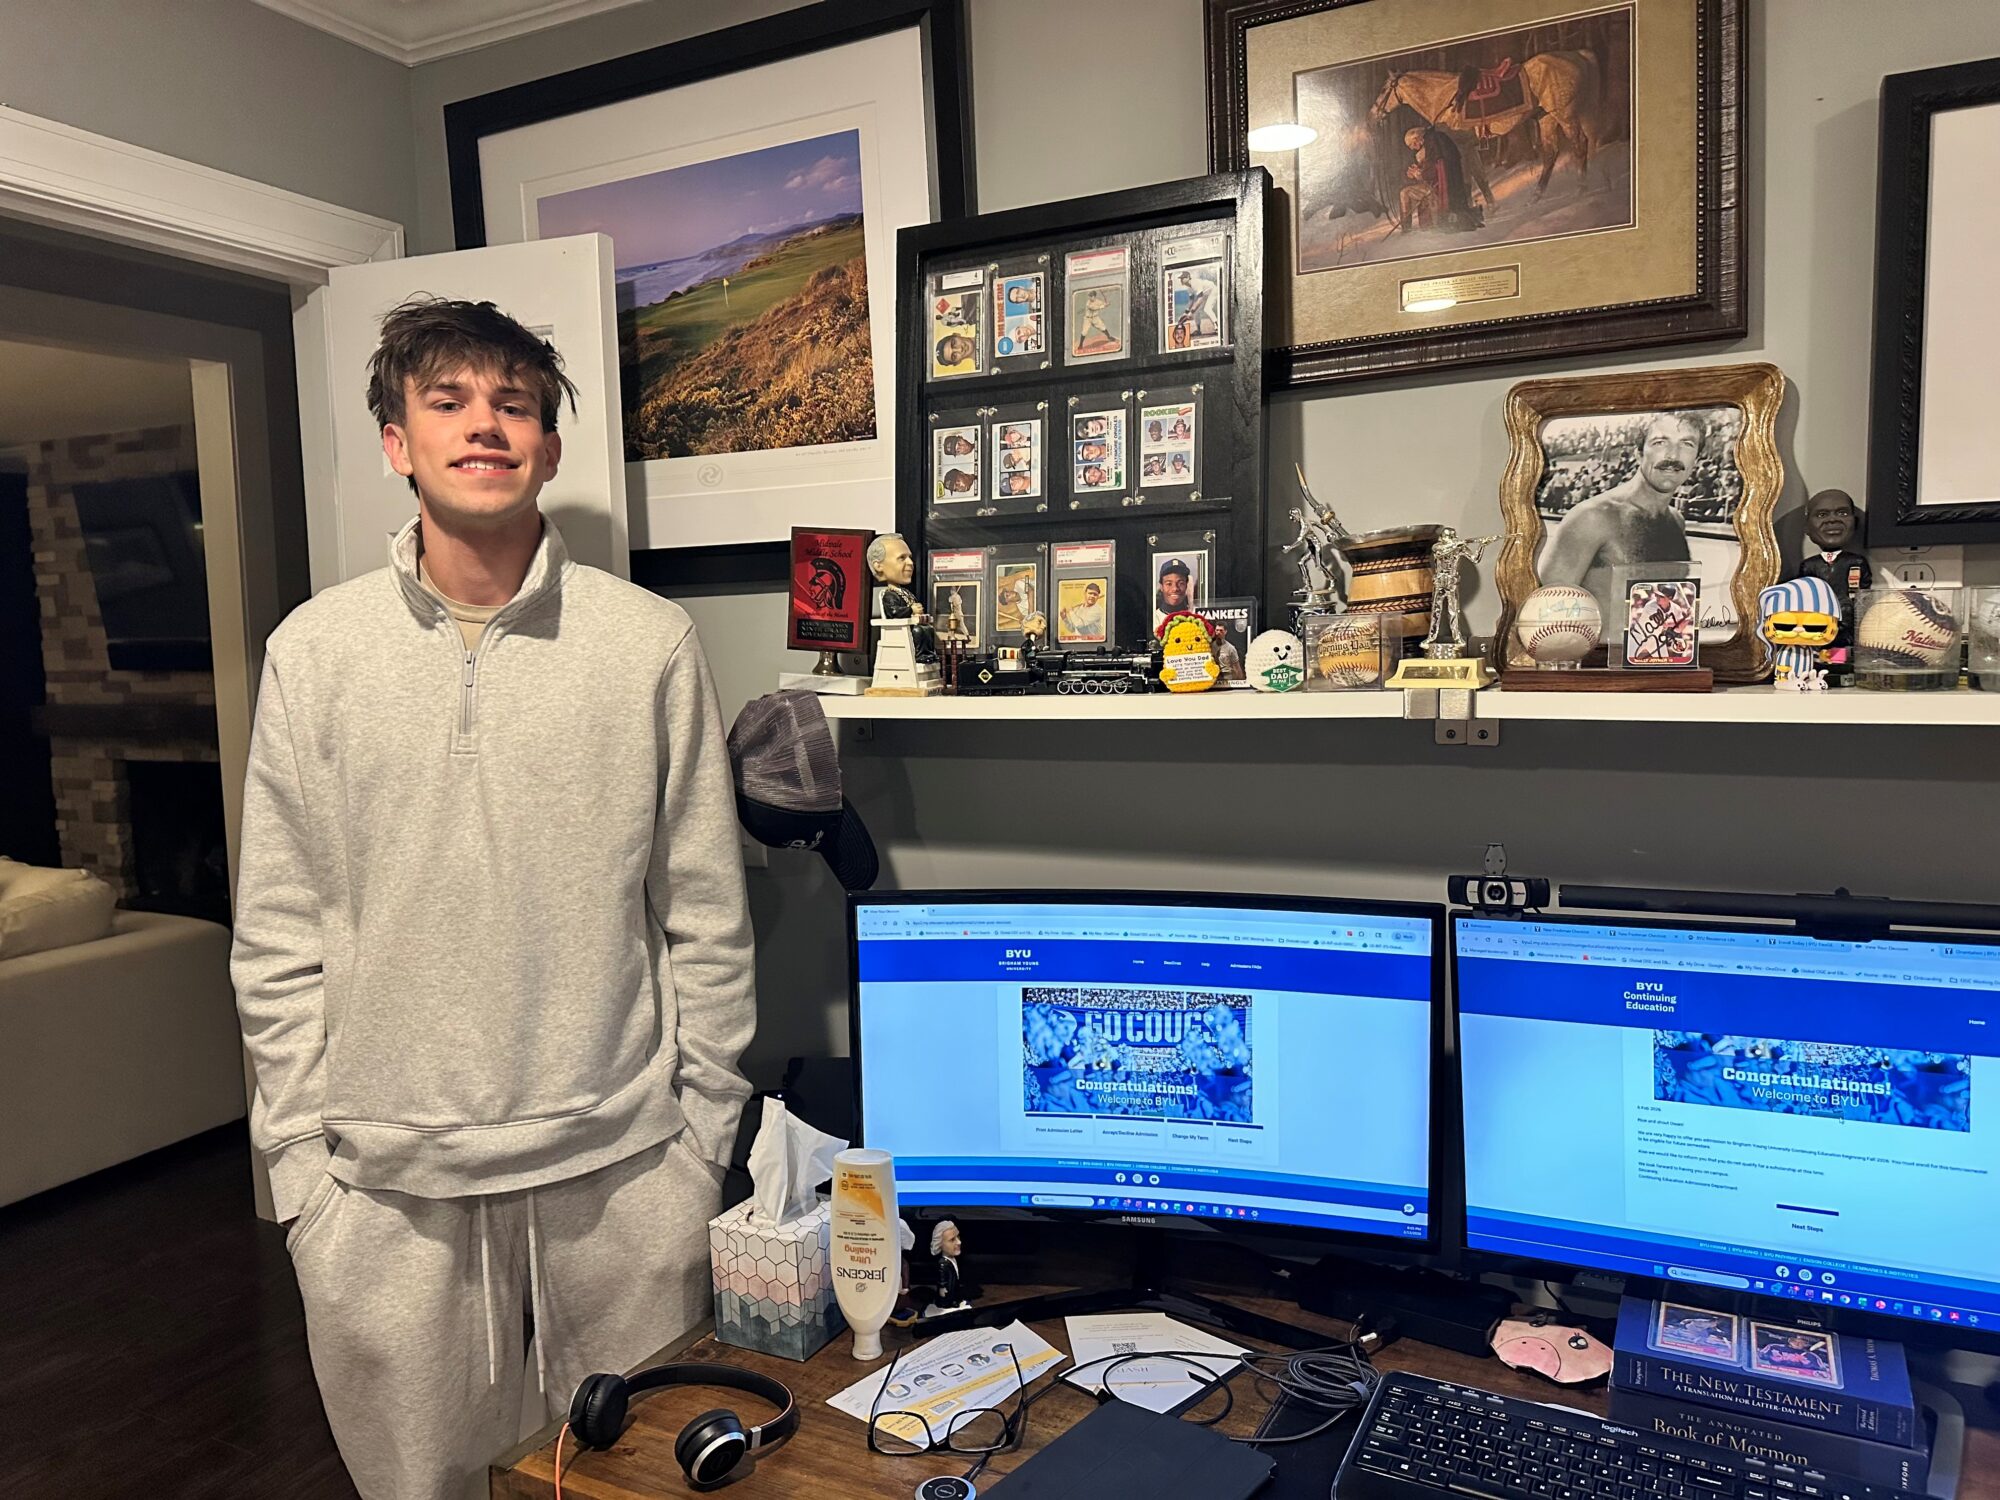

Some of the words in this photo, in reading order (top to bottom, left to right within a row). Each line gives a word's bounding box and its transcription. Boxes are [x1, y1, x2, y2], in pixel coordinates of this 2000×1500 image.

[1197, 608, 1248, 620] YANKEES
[1006, 950, 1031, 958] BYU
[1636, 982, 1663, 992] BYU
[1624, 991, 1677, 1005] Continuing
[1626, 1001, 1675, 1013] Education
[1076, 1079, 1198, 1095] Congratulations!
[1722, 1067, 1891, 1095] Congratulations!
[1097, 1095, 1141, 1105] Welcome
[1142, 1097, 1152, 1106] to
[1155, 1096, 1176, 1106] BYU
[1752, 1087, 1811, 1102] Welcome
[1814, 1092, 1828, 1104] to
[1831, 1094, 1859, 1107] BYU
[1121, 1216, 1156, 1224] SAMSUNG
[844, 1244, 877, 1255] Healing
[850, 1254, 871, 1264] Ultra
[836, 1267, 887, 1282] JERGENS
[1660, 1367, 1692, 1385] THE
[1700, 1375, 1739, 1393] NEW
[1744, 1383, 1843, 1415] TESTAMENT
[1683, 1385, 1733, 1402] TRANSLATION
[1735, 1397, 1750, 1405] FOR
[1752, 1400, 1796, 1414] LATTER-DAY
[1798, 1409, 1825, 1421] SAINTS
[1601, 1423, 1638, 1437] logitech
[1678, 1413, 1701, 1423] THE
[1708, 1420, 1782, 1441] ANNOTATED
[1653, 1418, 1698, 1440] Book
[1704, 1433, 1726, 1445] of
[1729, 1435, 1808, 1465] Mormon
